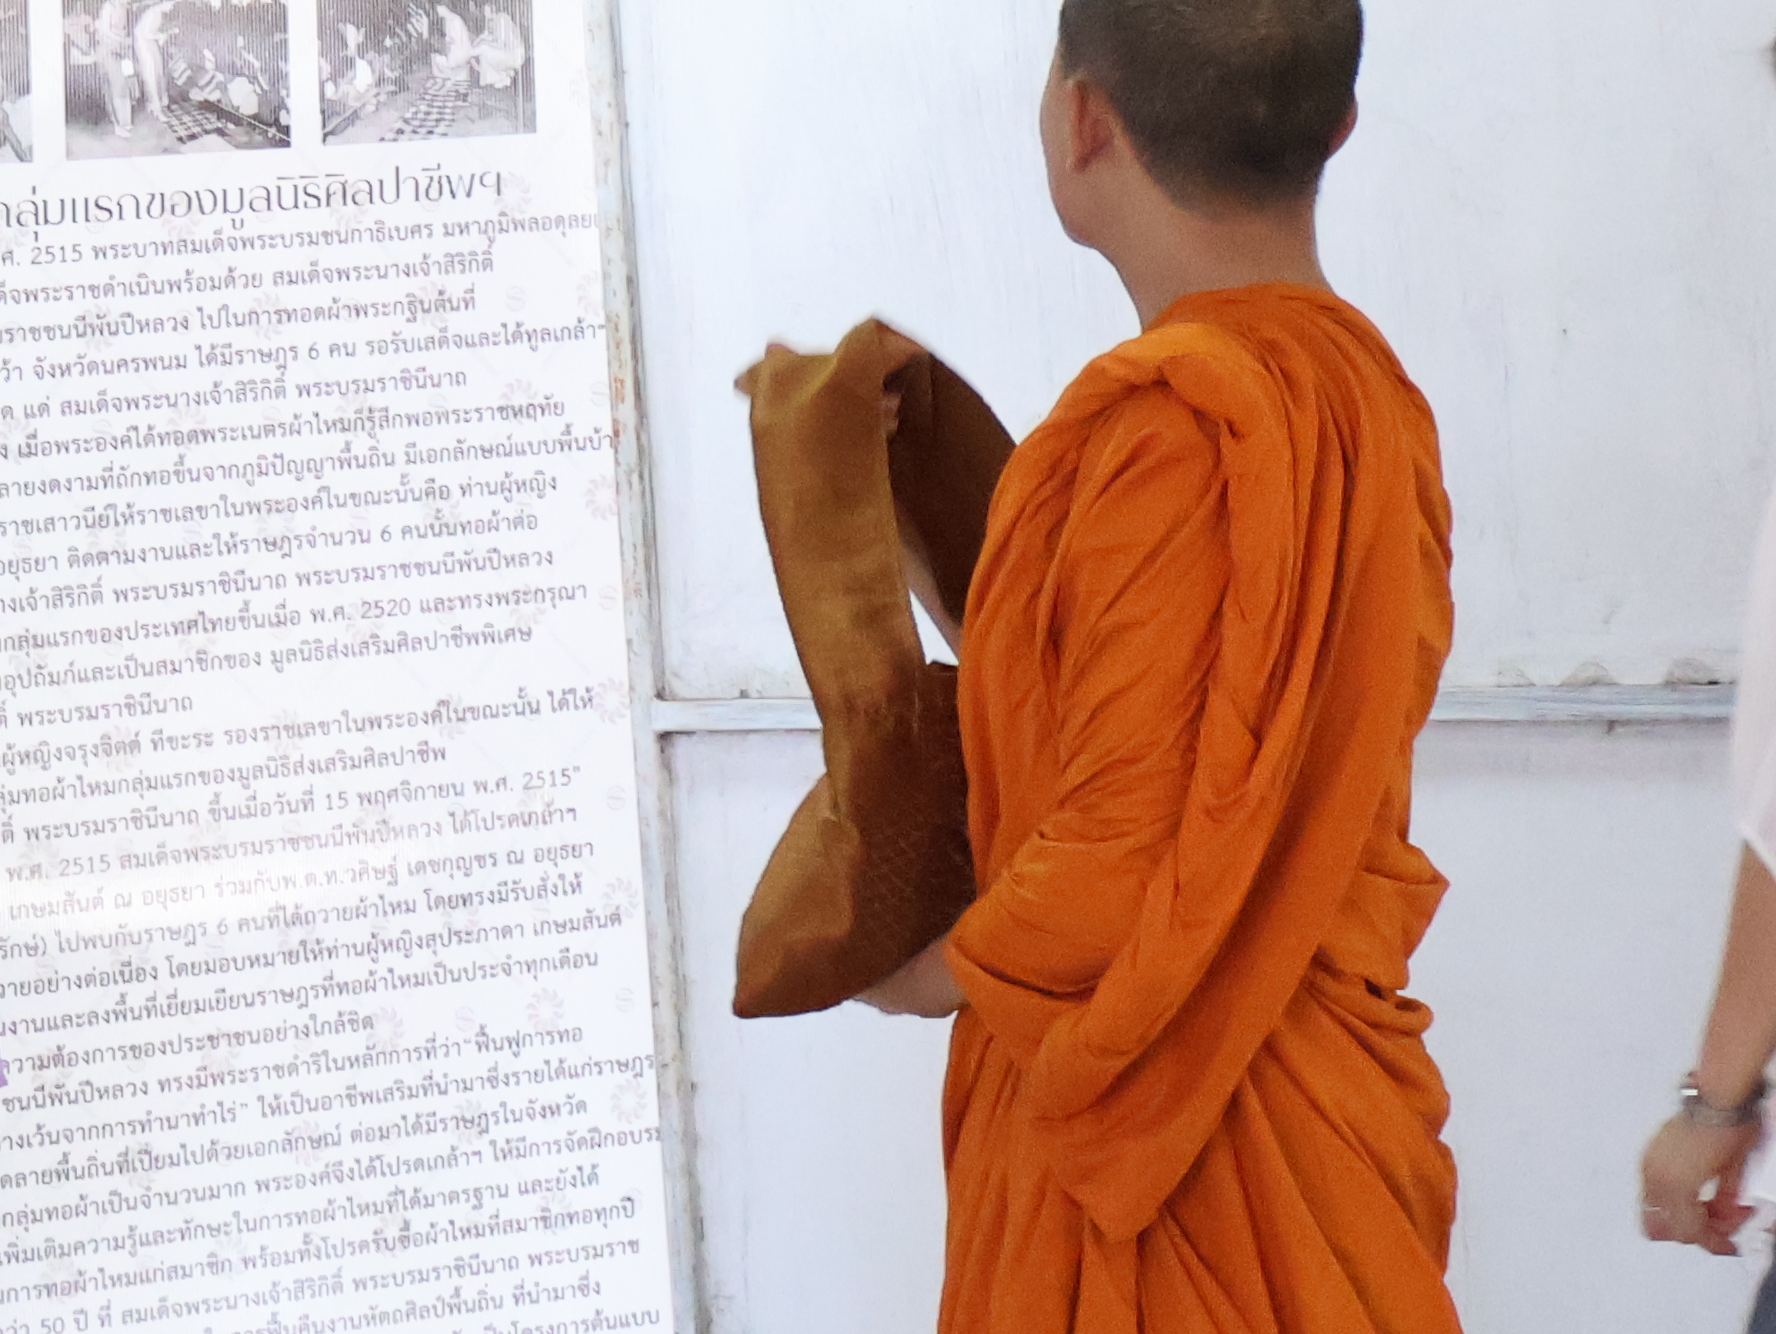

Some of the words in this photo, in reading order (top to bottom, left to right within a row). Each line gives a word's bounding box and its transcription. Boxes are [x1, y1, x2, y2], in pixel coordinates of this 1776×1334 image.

[30, 242, 83, 267] 2515
[32, 352, 187, 382] จังหวัดนครพนม
[194, 341, 299, 372] ได้มีราษฎร
[307, 341, 320, 361] 6
[328, 341, 356, 360] คน
[365, 313, 606, 357] รอรับเสด็จและได้ทูลเกล้า
[294, 365, 468, 400] พระบรมราชินีนาถ
[458, 469, 558, 504] ท่านผู้หญิง
[380, 524, 392, 543] 6
[112, 568, 287, 605] พระบรมราชินีนาถ
[309, 603, 350, 624] พ.ศ.
[359, 596, 412, 621] 2520
[419, 583, 588, 615] และทรงพระกรุณา
[16, 691, 193, 729] พระบรมราชินีนาถ
[22, 804, 200, 843] พระบรมราชินีนาถ
[324, 789, 350, 812] 15
[356, 779, 465, 810] พฤศจิกายน
[472, 775, 515, 795] พ.ศ.
[57, 852, 112, 878] 2515
[142, 884, 206, 912] อยุธยา
[533, 840, 595, 869] อยุธยา
[215, 919, 230, 936] 6
[351, 1252, 519, 1293] พระบรมราชินีนาถ
[526, 1238, 640, 1269] พระบรมราช
